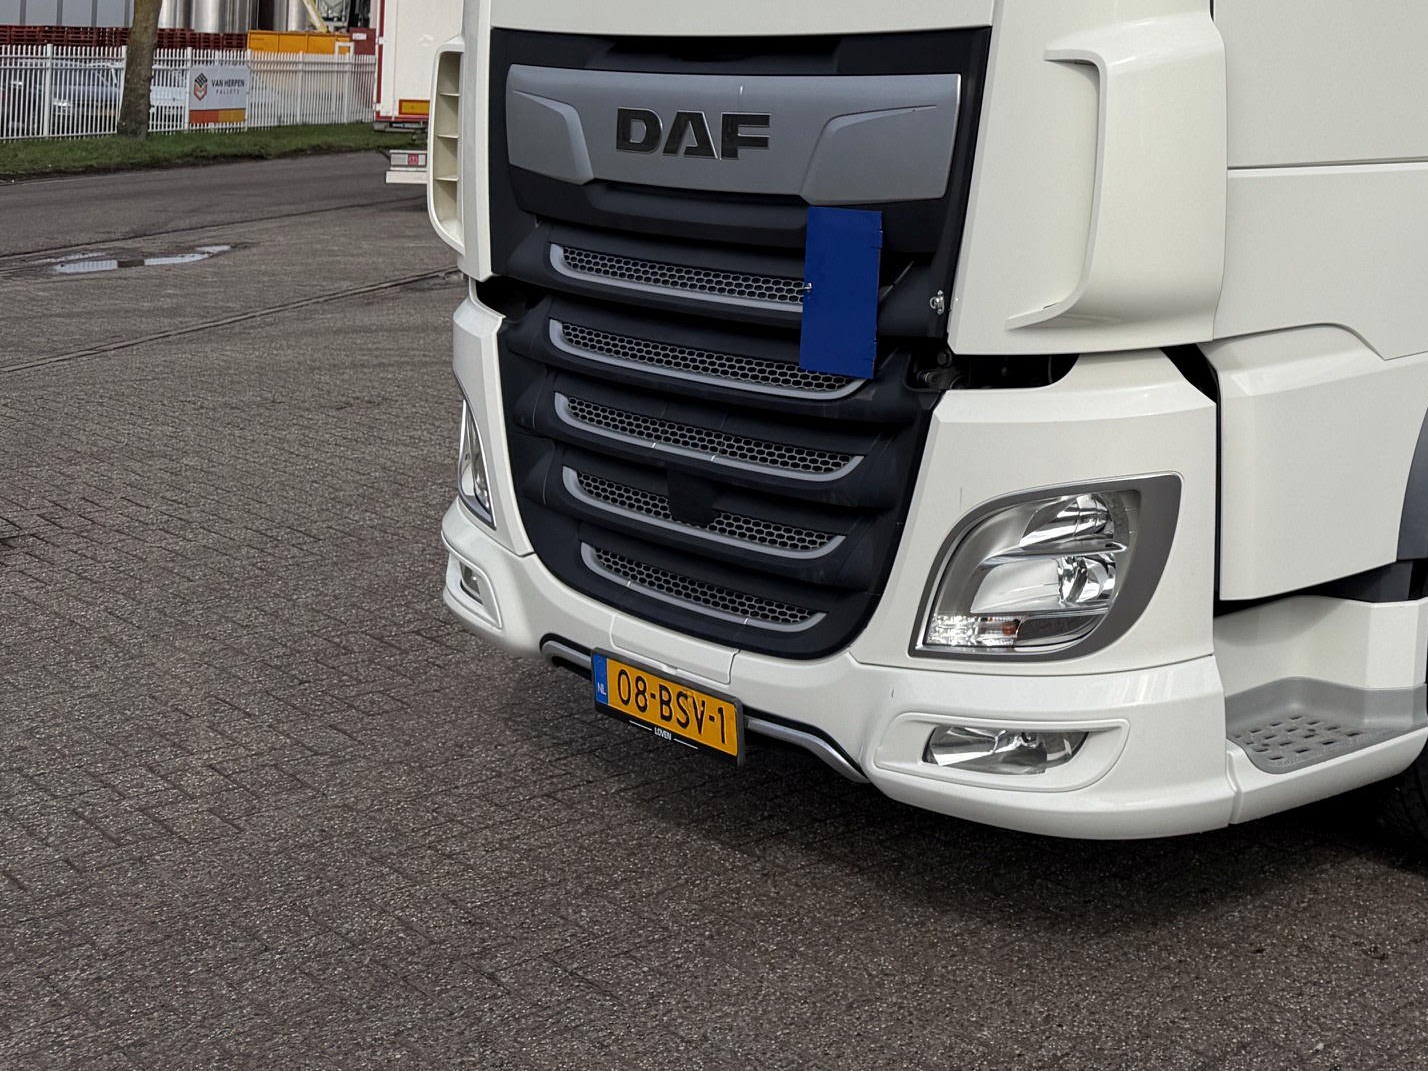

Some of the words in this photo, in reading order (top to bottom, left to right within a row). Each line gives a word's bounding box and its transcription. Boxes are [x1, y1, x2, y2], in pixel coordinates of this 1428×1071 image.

[211, 79, 224, 88] VAN
[224, 79, 245, 88] HERPEN
[616, 106, 771, 160] DAF
[597, 683, 607, 696] NL
[617, 668, 727, 745] 08-BSV-1
[654, 727, 672, 741] LOVEN
